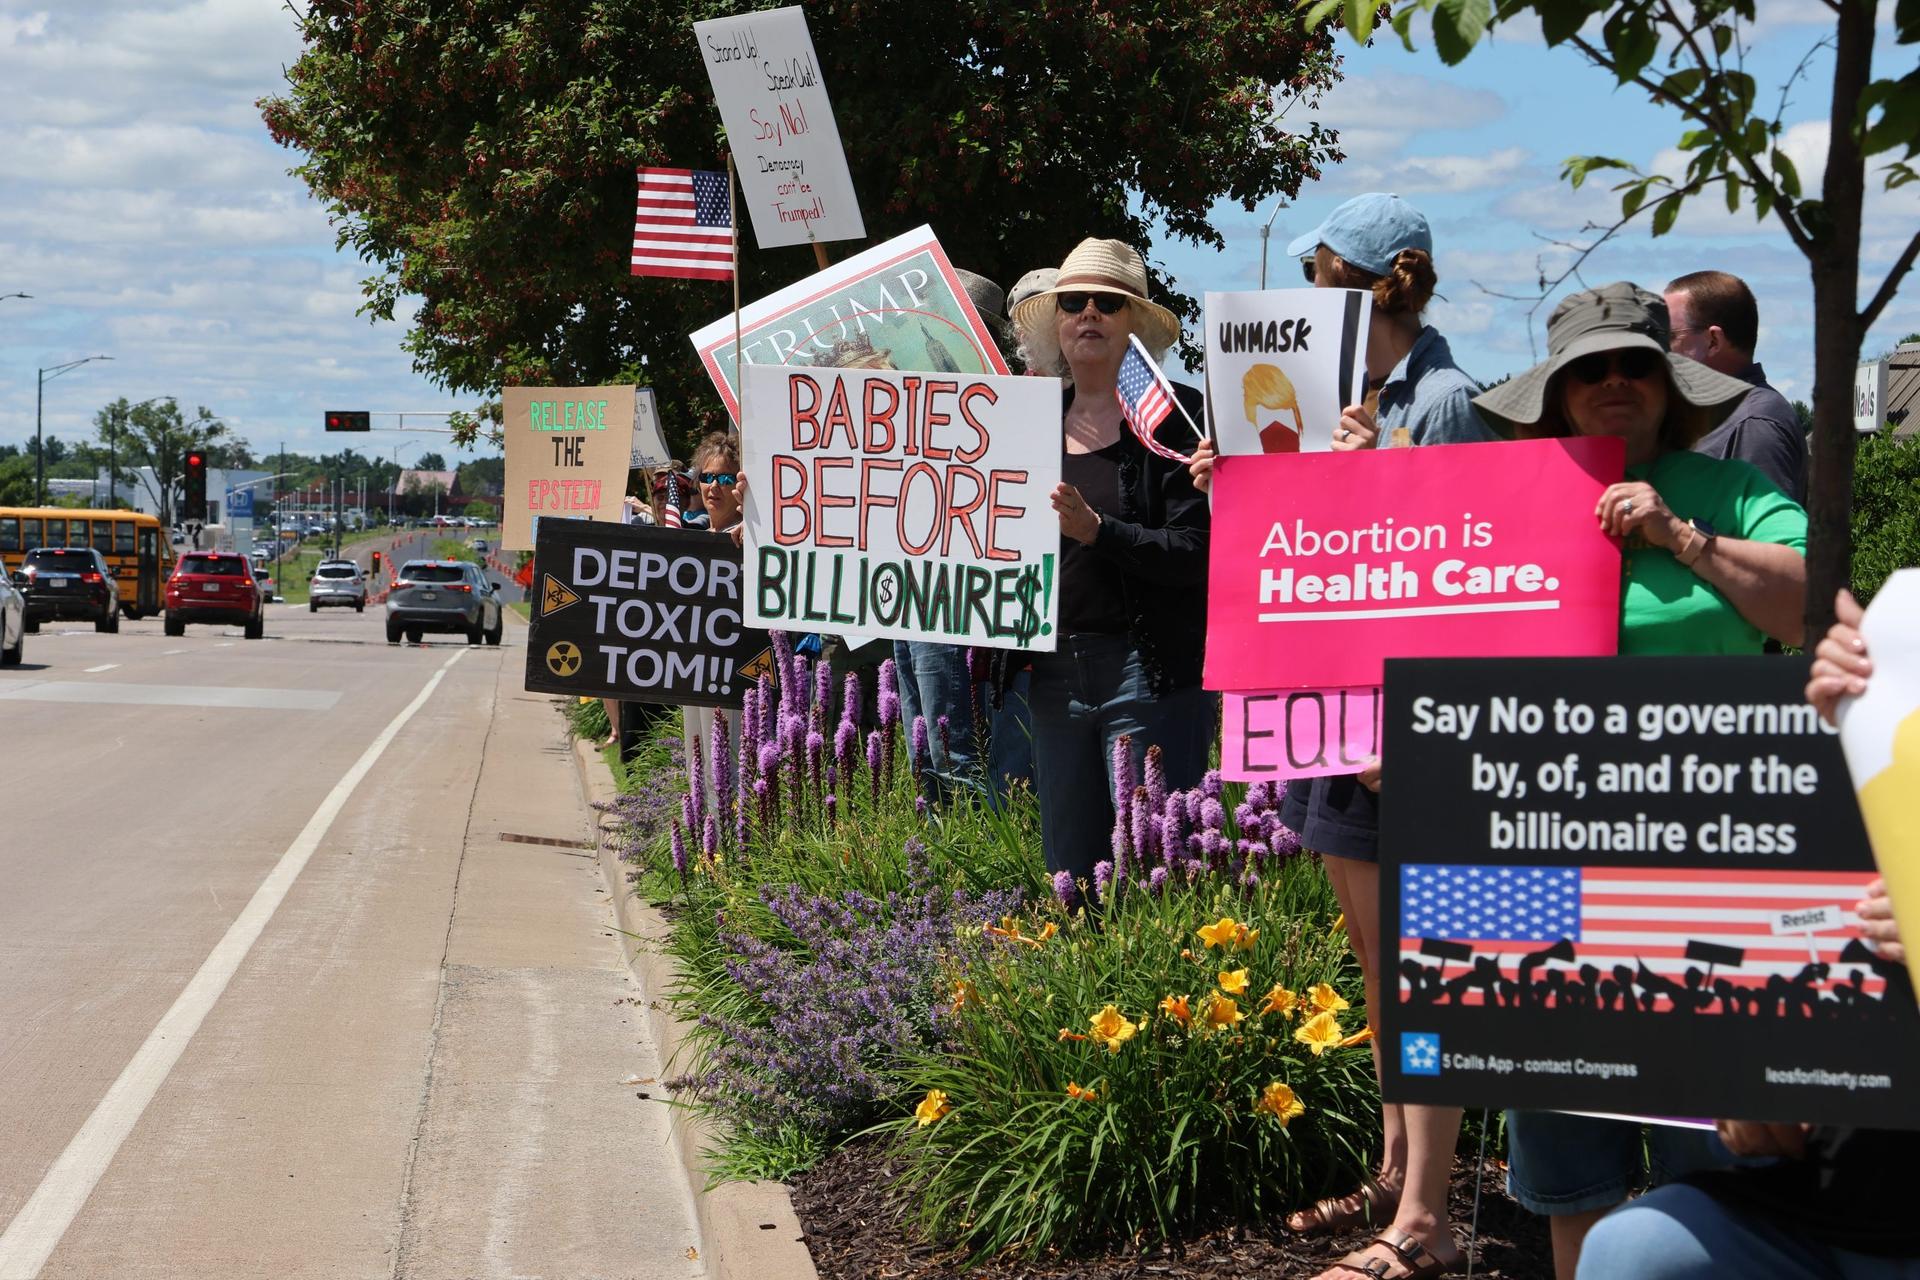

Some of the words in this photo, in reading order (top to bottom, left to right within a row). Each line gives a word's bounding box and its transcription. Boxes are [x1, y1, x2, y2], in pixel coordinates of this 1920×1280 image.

[706, 31, 741, 63] Stand
[738, 25, 760, 71] Up!
[763, 58, 796, 101] Speak
[792, 51, 818, 88] Out!
[749, 108, 782, 146] Say
[779, 98, 810, 136] No!
[757, 155, 804, 175] Democracy
[798, 180, 812, 193] be
[771, 196, 826, 229] Trumped!
[726, 267, 930, 367] TRUMP
[1219, 318, 1312, 354] UNMASK
[530, 400, 608, 432] RELEASE
[788, 373, 998, 464] BABIES
[551, 436, 585, 467] THE
[528, 479, 602, 510] EPSTEIN
[771, 455, 1029, 561] BEFORE
[1259, 519, 1446, 558] Abortion
[1463, 512, 1493, 548] is
[573, 547, 744, 600] DEPOR
[1258, 561, 1418, 604] Health
[1432, 559, 1560, 597] Care.
[589, 595, 741, 647] TOXIC
[599, 645, 734, 695] TOM!!
[1243, 687, 1379, 773] EQU
[1411, 697, 1480, 740] Say
[1489, 696, 1544, 734] No
[1553, 697, 1595, 734] to
[1603, 704, 1628, 734] a
[1471, 753, 1527, 798] by,
[1536, 753, 1587, 797] of,
[1596, 755, 1672, 793] and
[1680, 755, 1741, 794] for
[1750, 755, 1819, 795] the
[1489, 811, 1688, 852] billionaire
[1697, 814, 1798, 854] class
[1781, 910, 1825, 927] Resist
[1442, 1053, 1450, 1069] 5
[1453, 1053, 1485, 1070] Calls
[1487, 1055, 1514, 1073] App
[1523, 1058, 1573, 1074] contact
[1574, 1058, 1638, 1079] Congress
